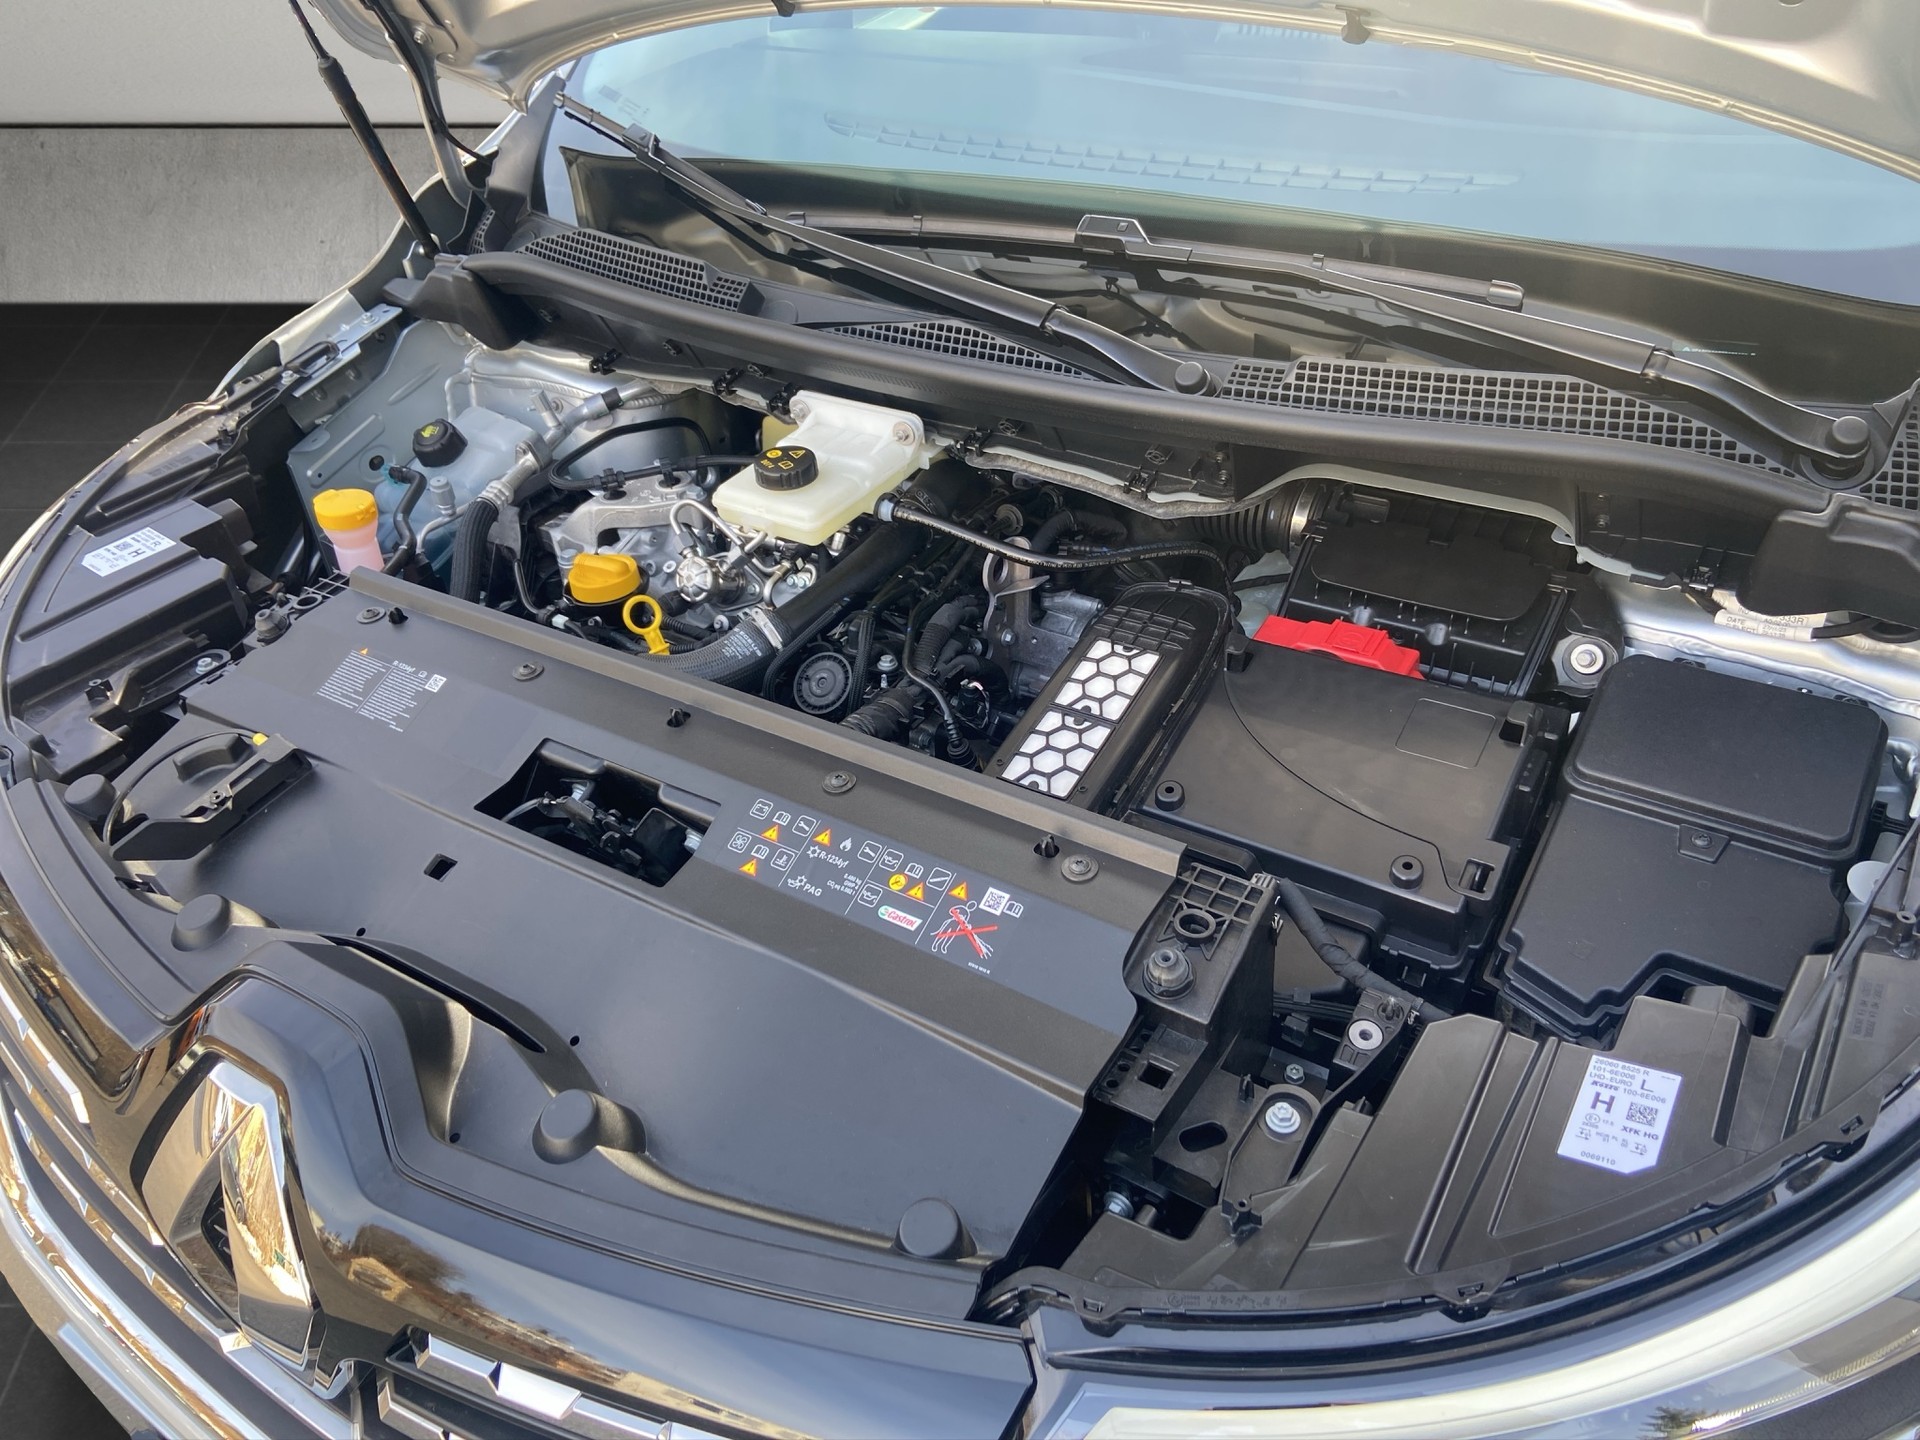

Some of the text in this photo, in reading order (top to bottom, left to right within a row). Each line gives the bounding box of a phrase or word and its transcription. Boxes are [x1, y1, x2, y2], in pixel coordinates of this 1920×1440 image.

[128, 548, 147, 558] H
[819, 852, 849, 869] R-1234yf
[803, 883, 823, 897] PAG
[886, 909, 918, 928] Castrol
[1640, 1079, 1654, 1093] L
[1590, 1091, 1616, 1114] H
[1621, 1125, 1641, 1136] XFK
